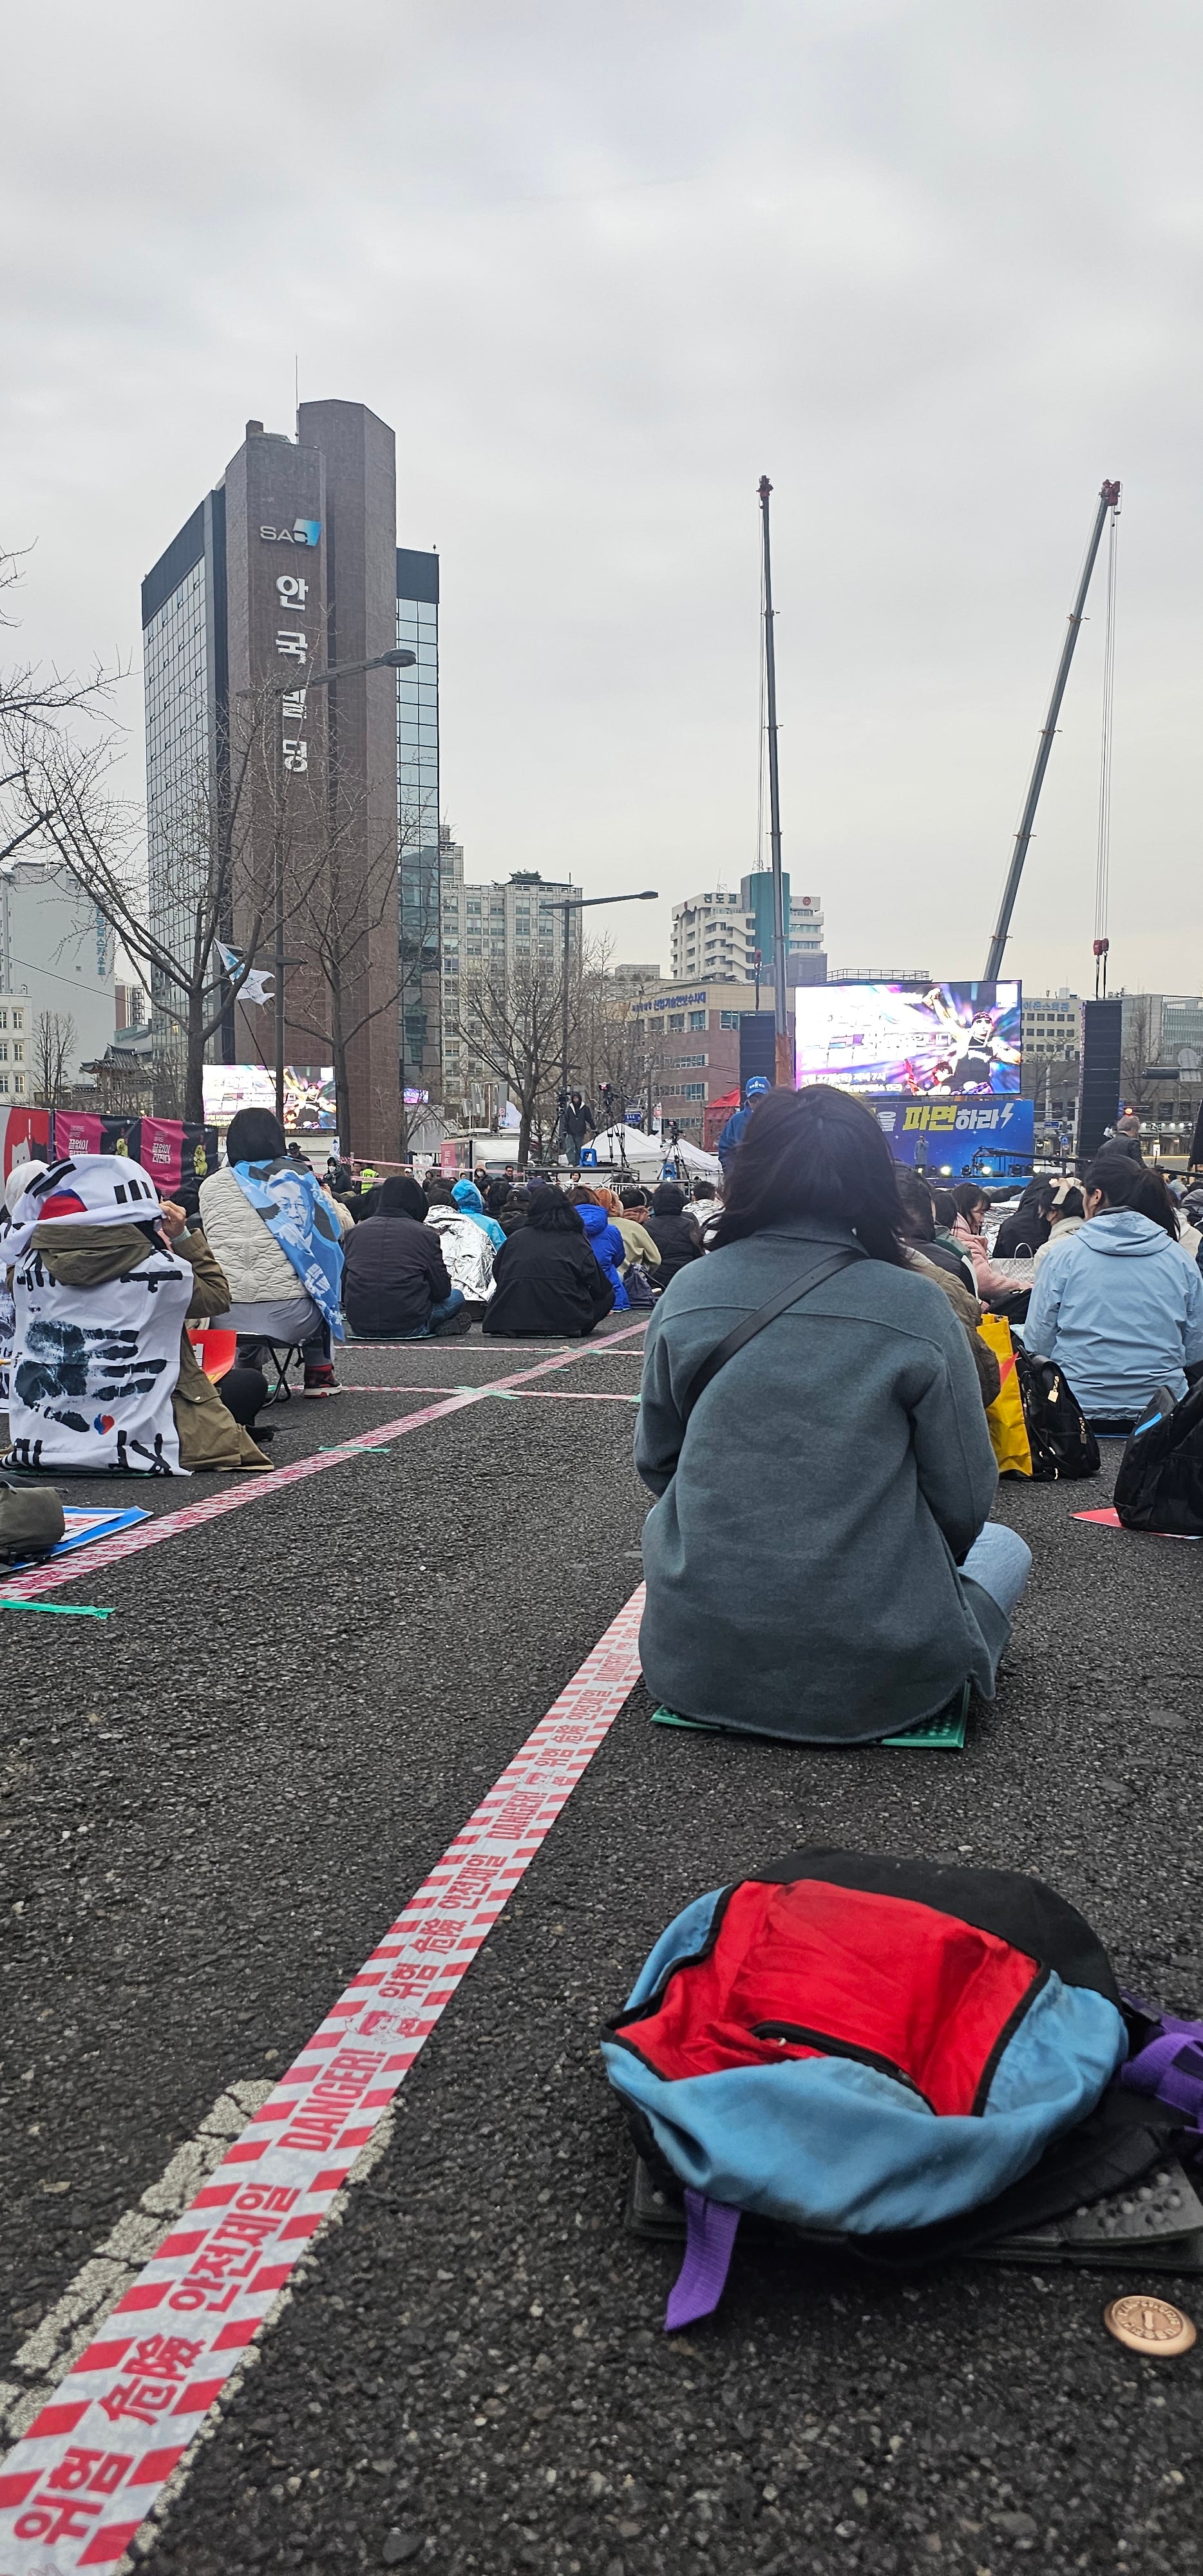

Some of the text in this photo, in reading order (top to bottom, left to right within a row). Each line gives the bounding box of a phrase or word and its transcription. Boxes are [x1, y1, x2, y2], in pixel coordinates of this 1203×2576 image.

[276, 575, 308, 772] 안국빌딩
[903, 1104, 999, 1131] 파면하라
[567, 1689, 612, 1721] 안전제일
[535, 1748, 575, 1767] 위험
[486, 1791, 548, 1840] DANGER!
[438, 1854, 508, 1910] 안전제일
[410, 1918, 468, 1955] 危險
[378, 1962, 440, 2000] 위험
[276, 2047, 387, 2152] DANGER!
[169, 2183, 301, 2312] 안전제일
[98, 2333, 206, 2426] 危險
[15, 2445, 135, 2545] 위험
